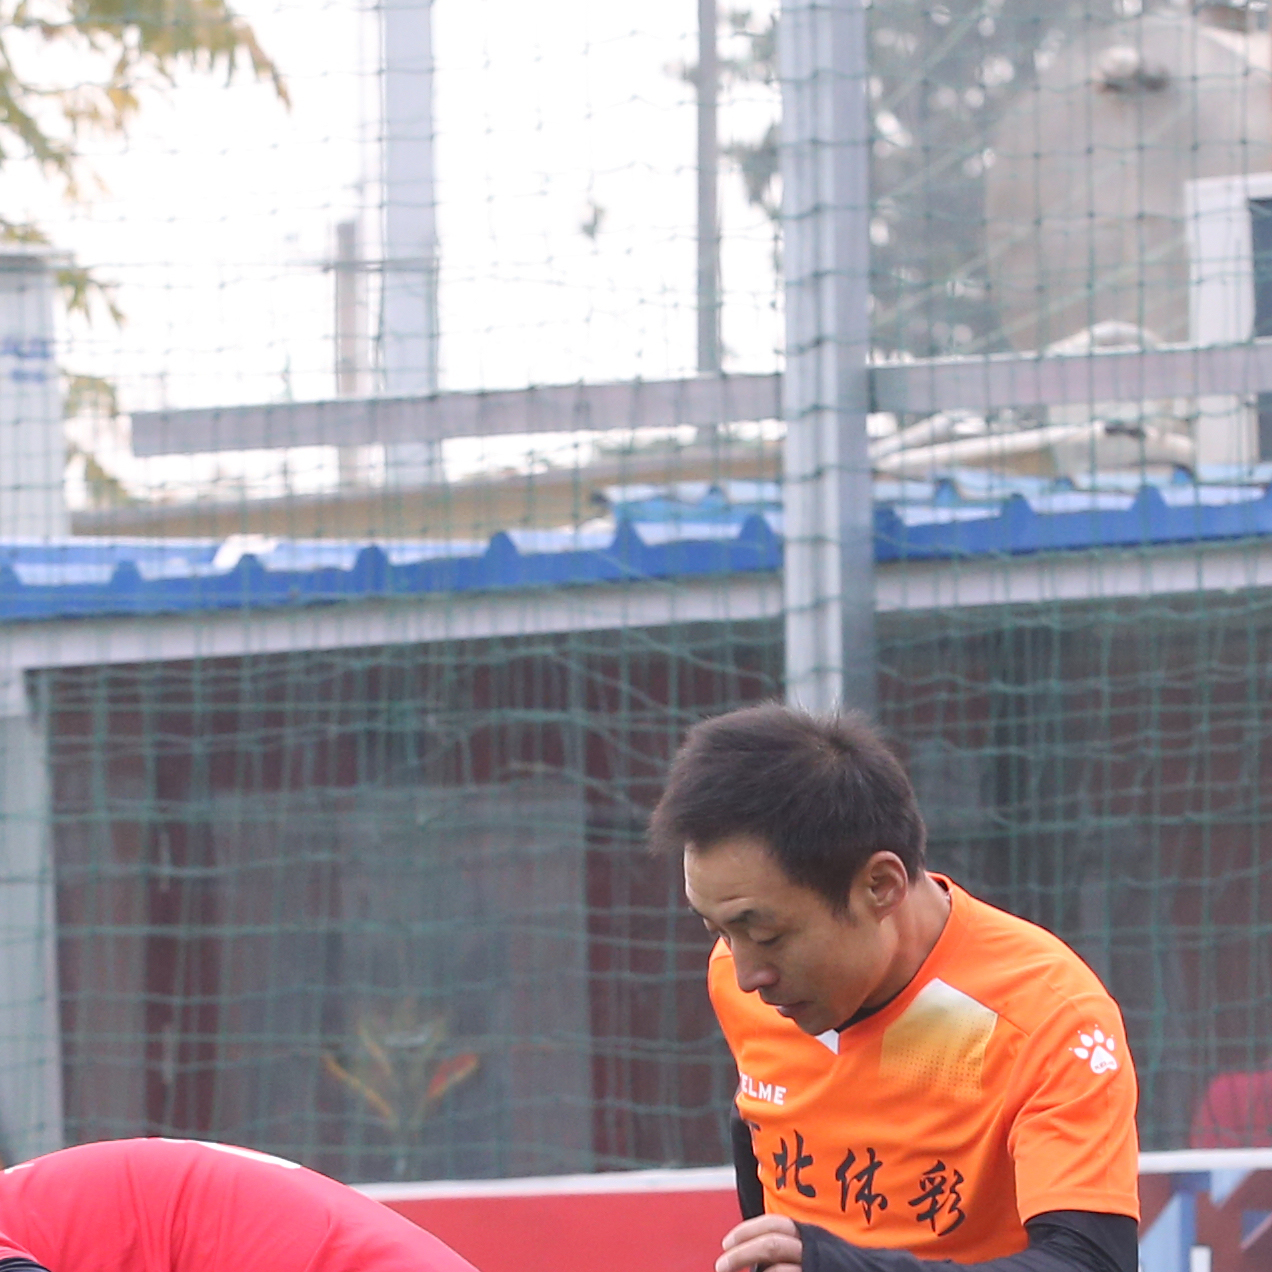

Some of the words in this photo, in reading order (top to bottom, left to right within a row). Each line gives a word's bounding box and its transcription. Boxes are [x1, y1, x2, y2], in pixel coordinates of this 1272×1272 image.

[739, 1072, 787, 1106] ELME
[749, 1122, 966, 1237] 北体彩
